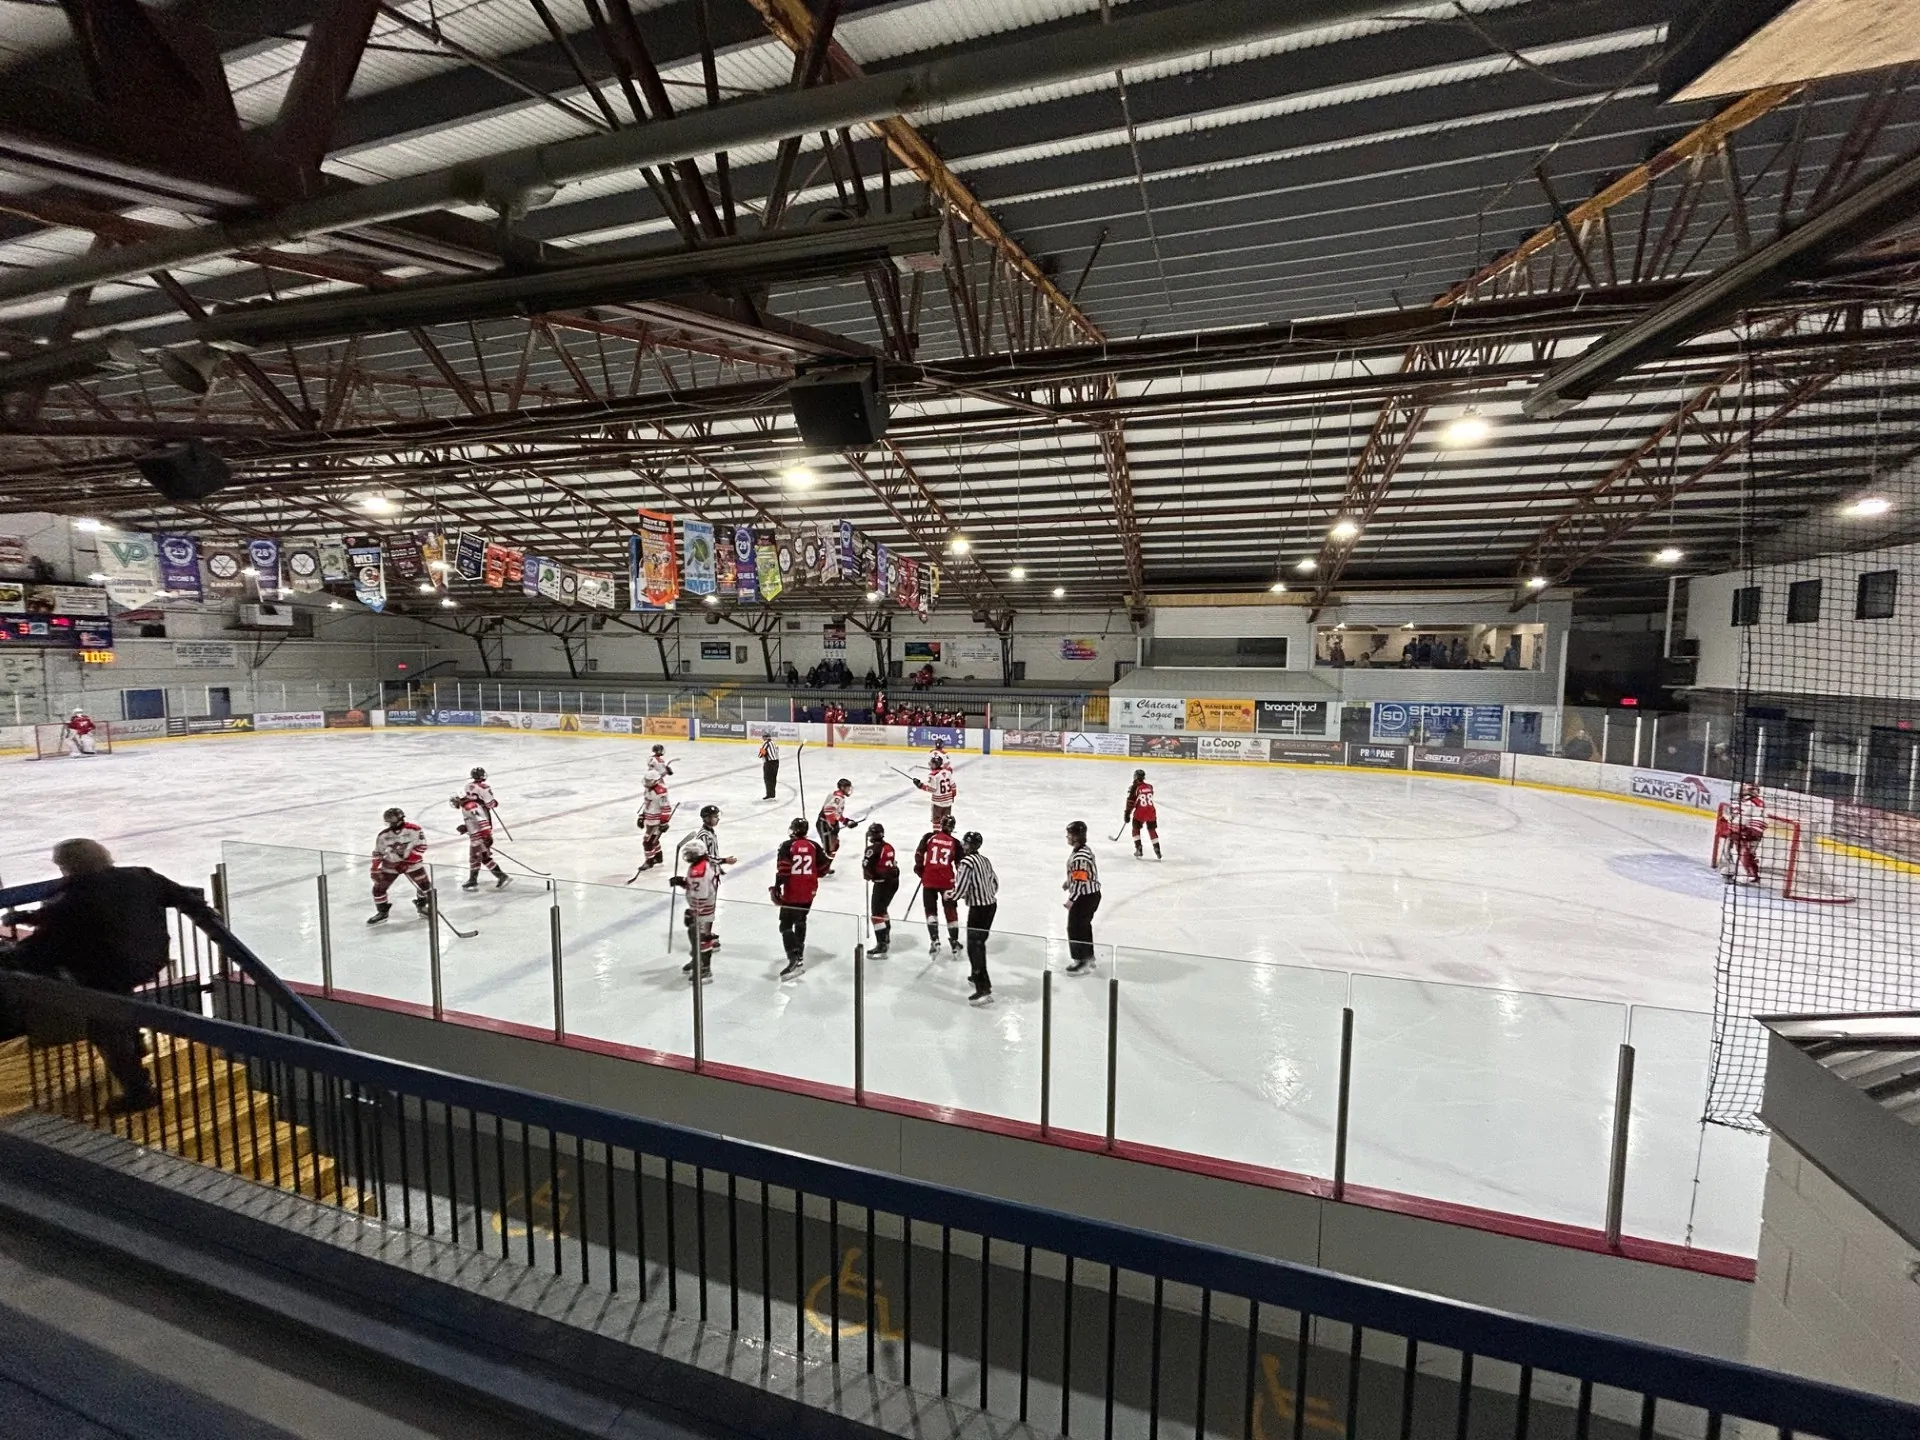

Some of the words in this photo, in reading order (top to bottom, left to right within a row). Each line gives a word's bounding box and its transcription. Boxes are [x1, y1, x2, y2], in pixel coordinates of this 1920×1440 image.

[1409, 706, 1474, 716] SPORTS
[1213, 738, 1241, 749] Coop
[940, 778, 951, 794] 63
[930, 846, 951, 865] 13
[791, 854, 813, 875] 22
